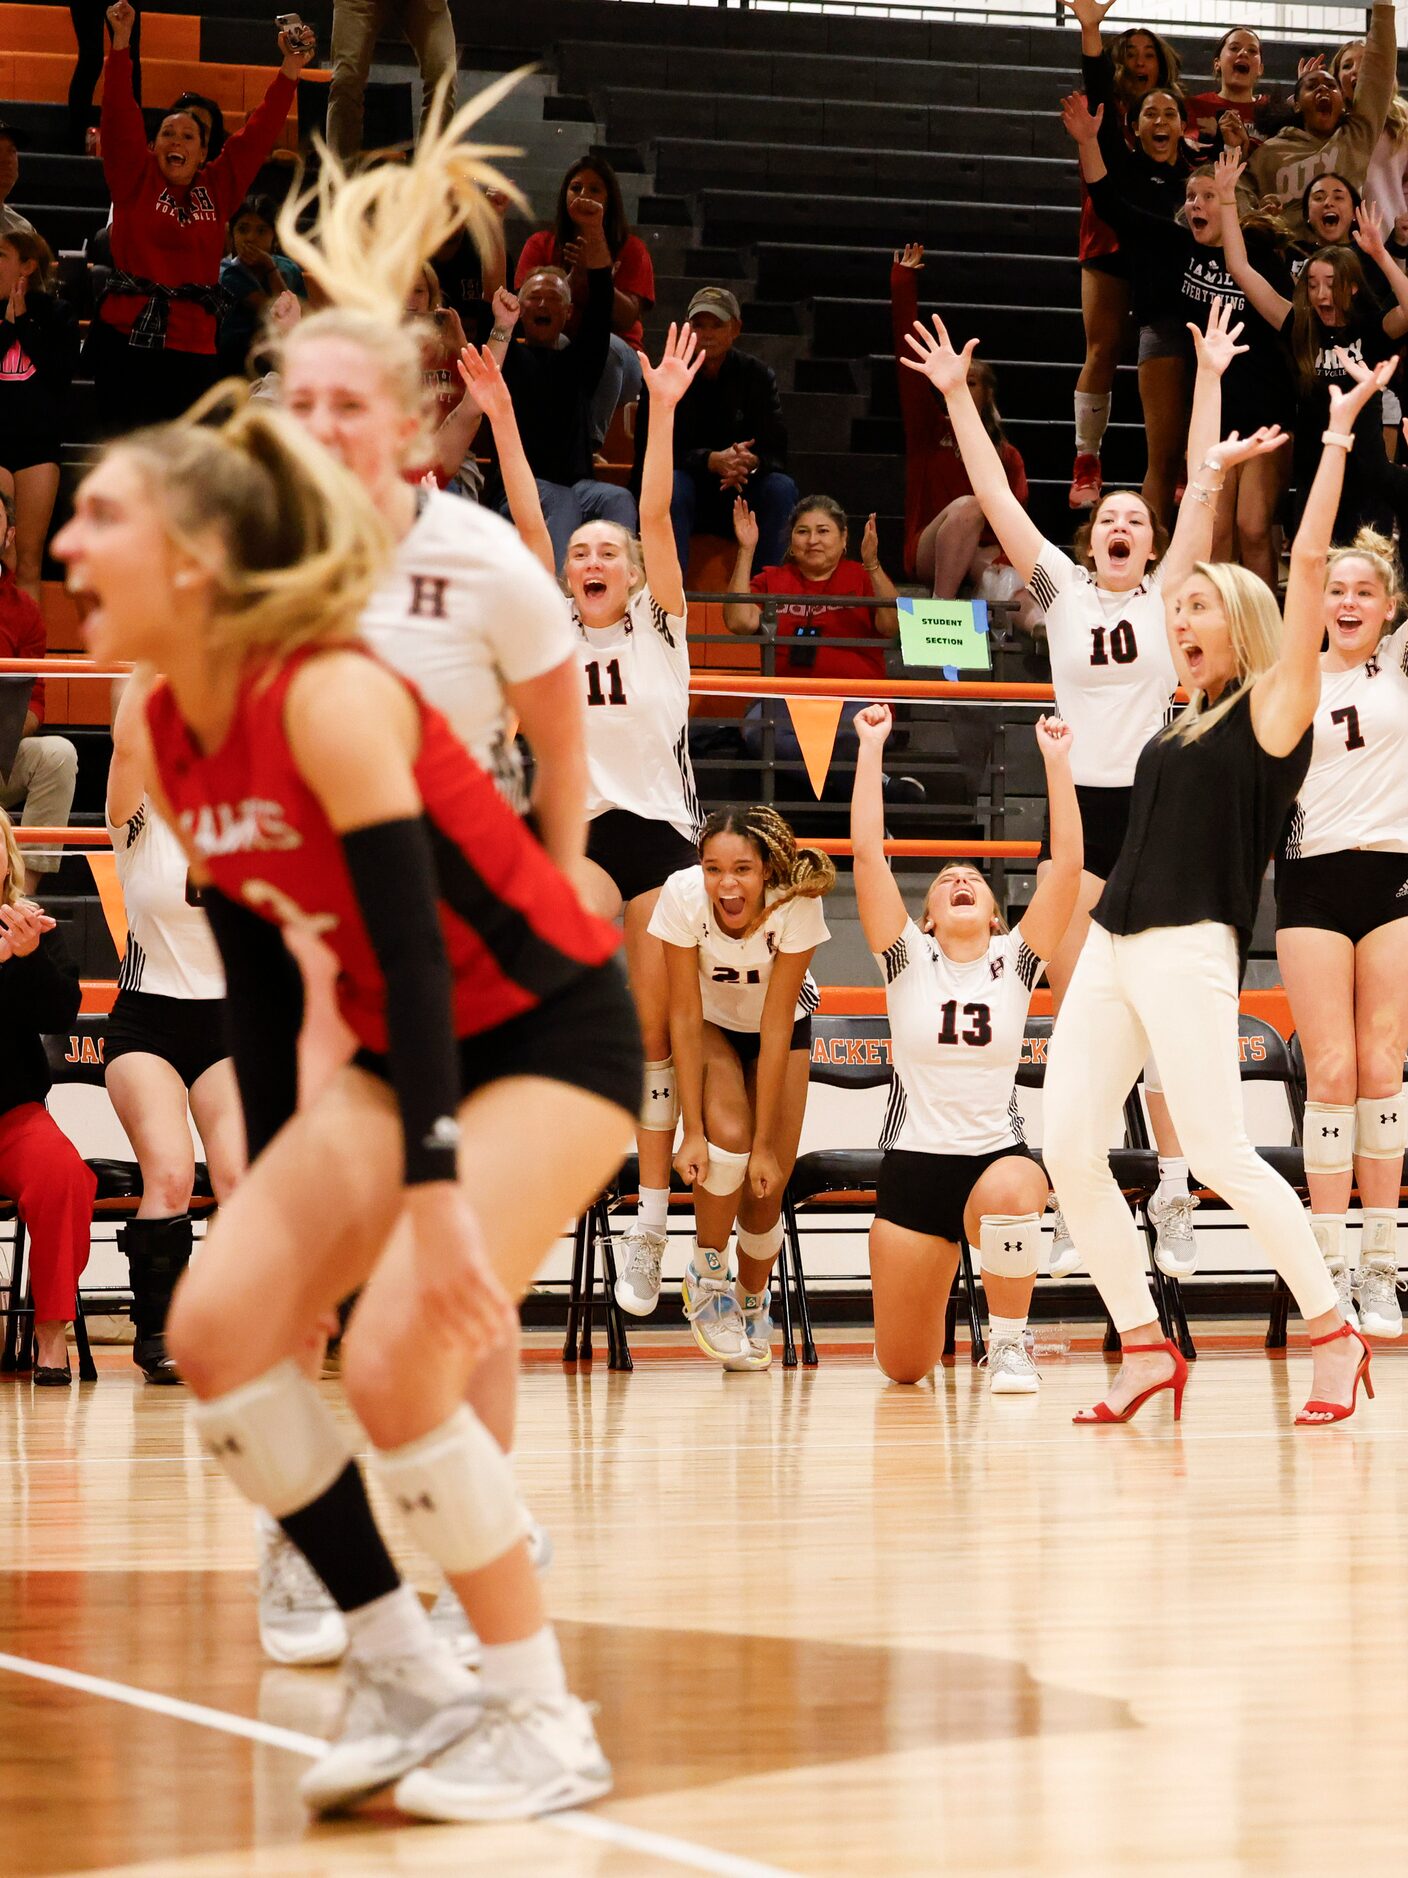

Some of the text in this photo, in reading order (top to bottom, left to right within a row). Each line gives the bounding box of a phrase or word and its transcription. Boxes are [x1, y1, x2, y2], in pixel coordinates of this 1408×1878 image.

[408, 573, 450, 620] H
[921, 618, 962, 627] STUDENT
[925, 636, 963, 646] SECTION
[1090, 619, 1139, 666] 10
[584, 658, 628, 706] 11
[1330, 704, 1366, 752] 7
[988, 956, 1006, 981] H
[937, 999, 993, 1047] 13
